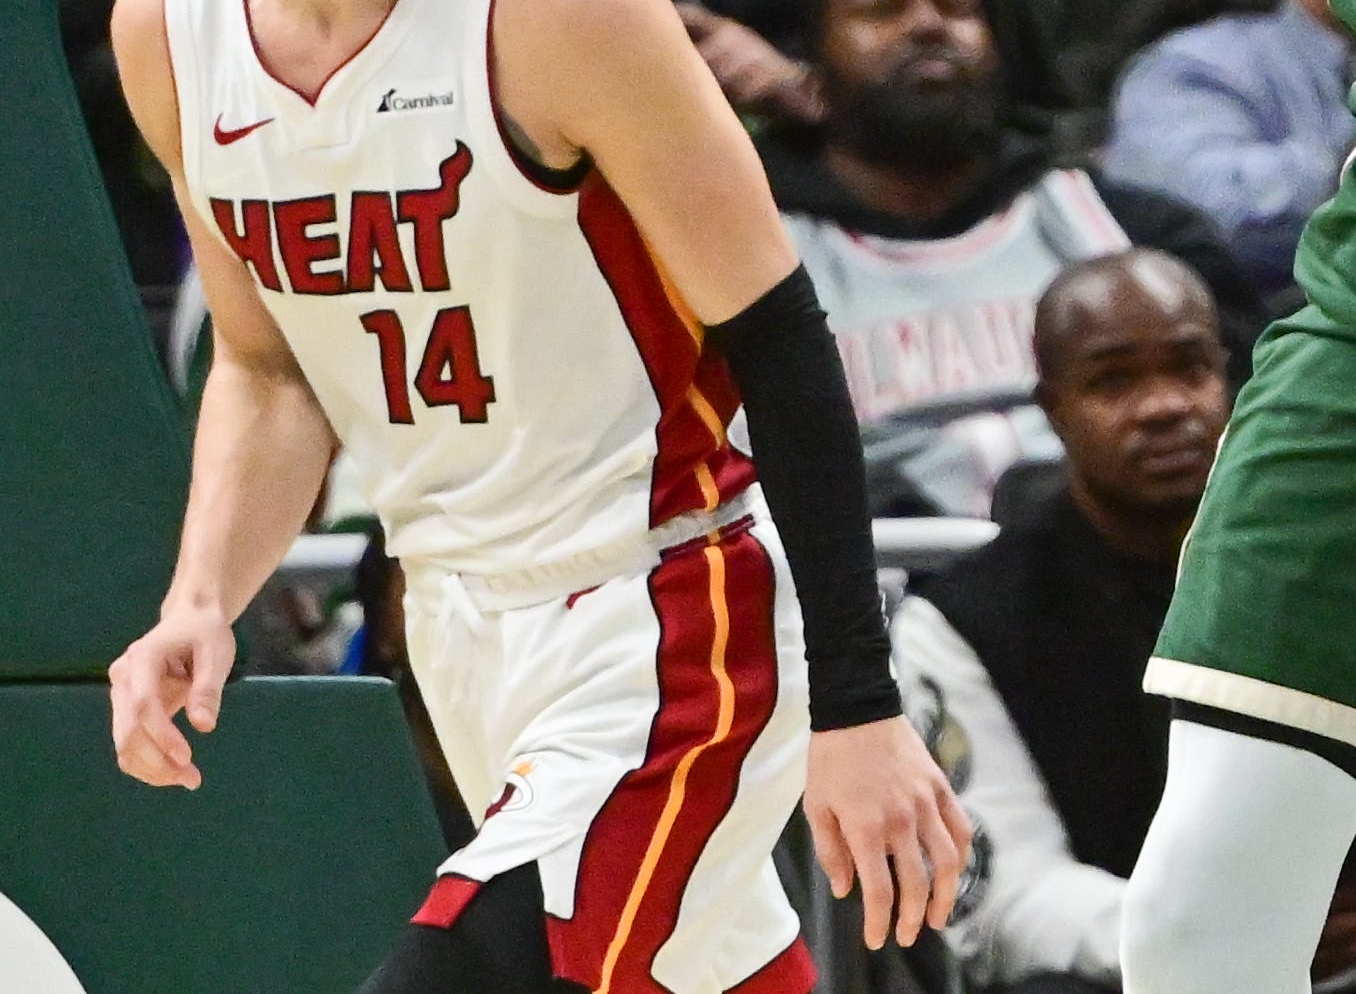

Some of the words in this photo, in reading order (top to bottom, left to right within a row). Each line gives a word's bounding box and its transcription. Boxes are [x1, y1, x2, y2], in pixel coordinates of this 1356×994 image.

[393, 91, 454, 110] Carnival
[209, 139, 474, 295] HEAT
[359, 304, 496, 424] 14
